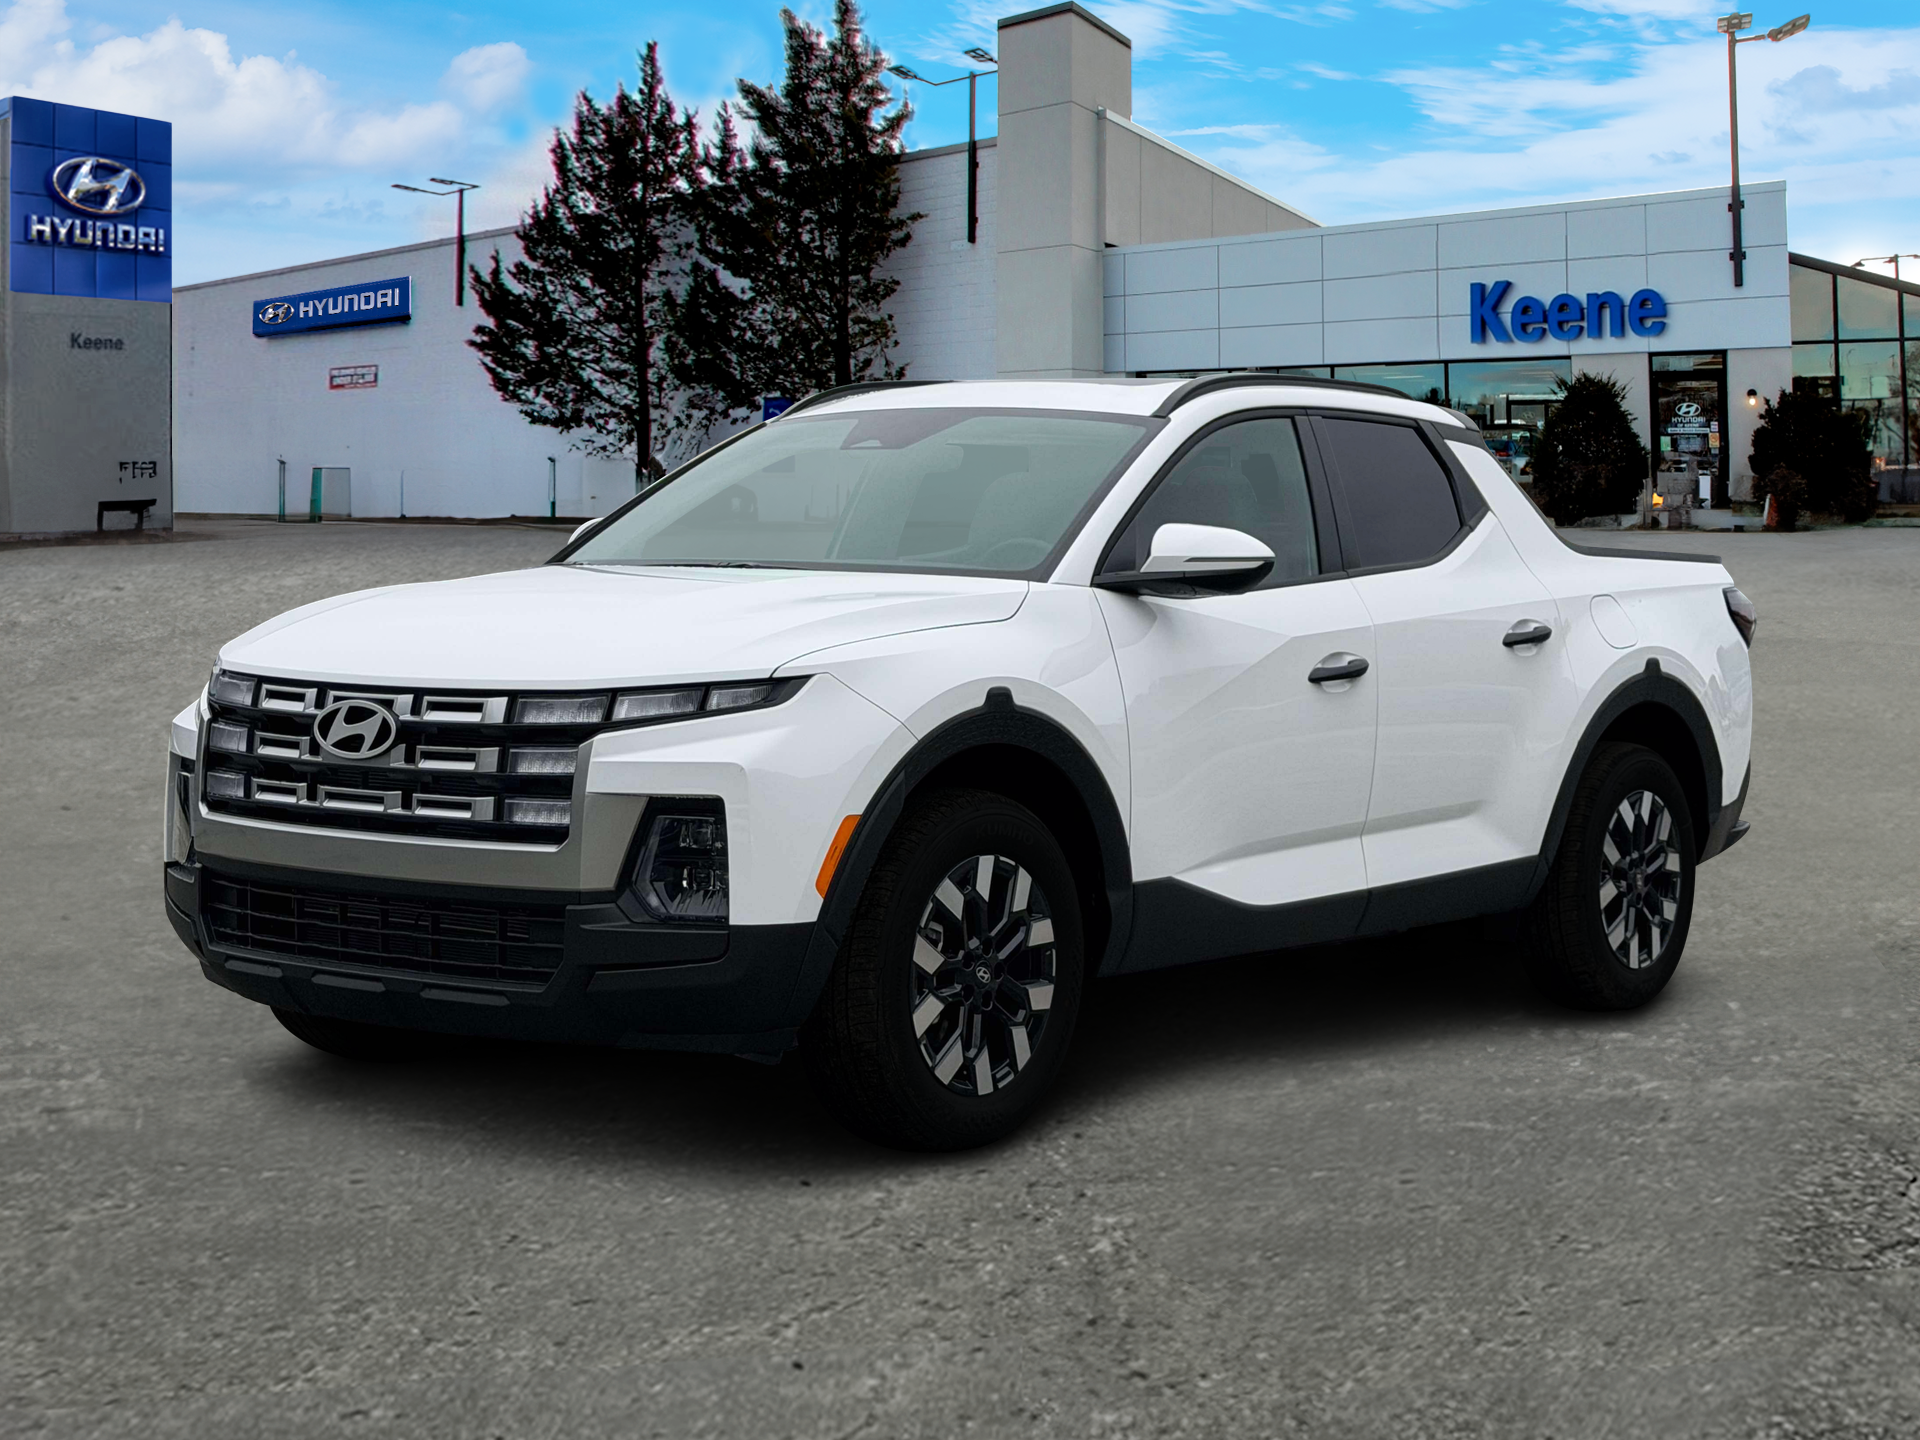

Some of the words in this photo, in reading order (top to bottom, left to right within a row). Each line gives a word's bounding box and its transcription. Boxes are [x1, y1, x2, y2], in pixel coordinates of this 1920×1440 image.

[29, 214, 165, 252] HYUNDAI
[299, 288, 400, 319] HYUNDAI
[1469, 279, 1668, 345] Keene
[70, 332, 125, 350] Keene
[975, 821, 1034, 845] KUMHO
